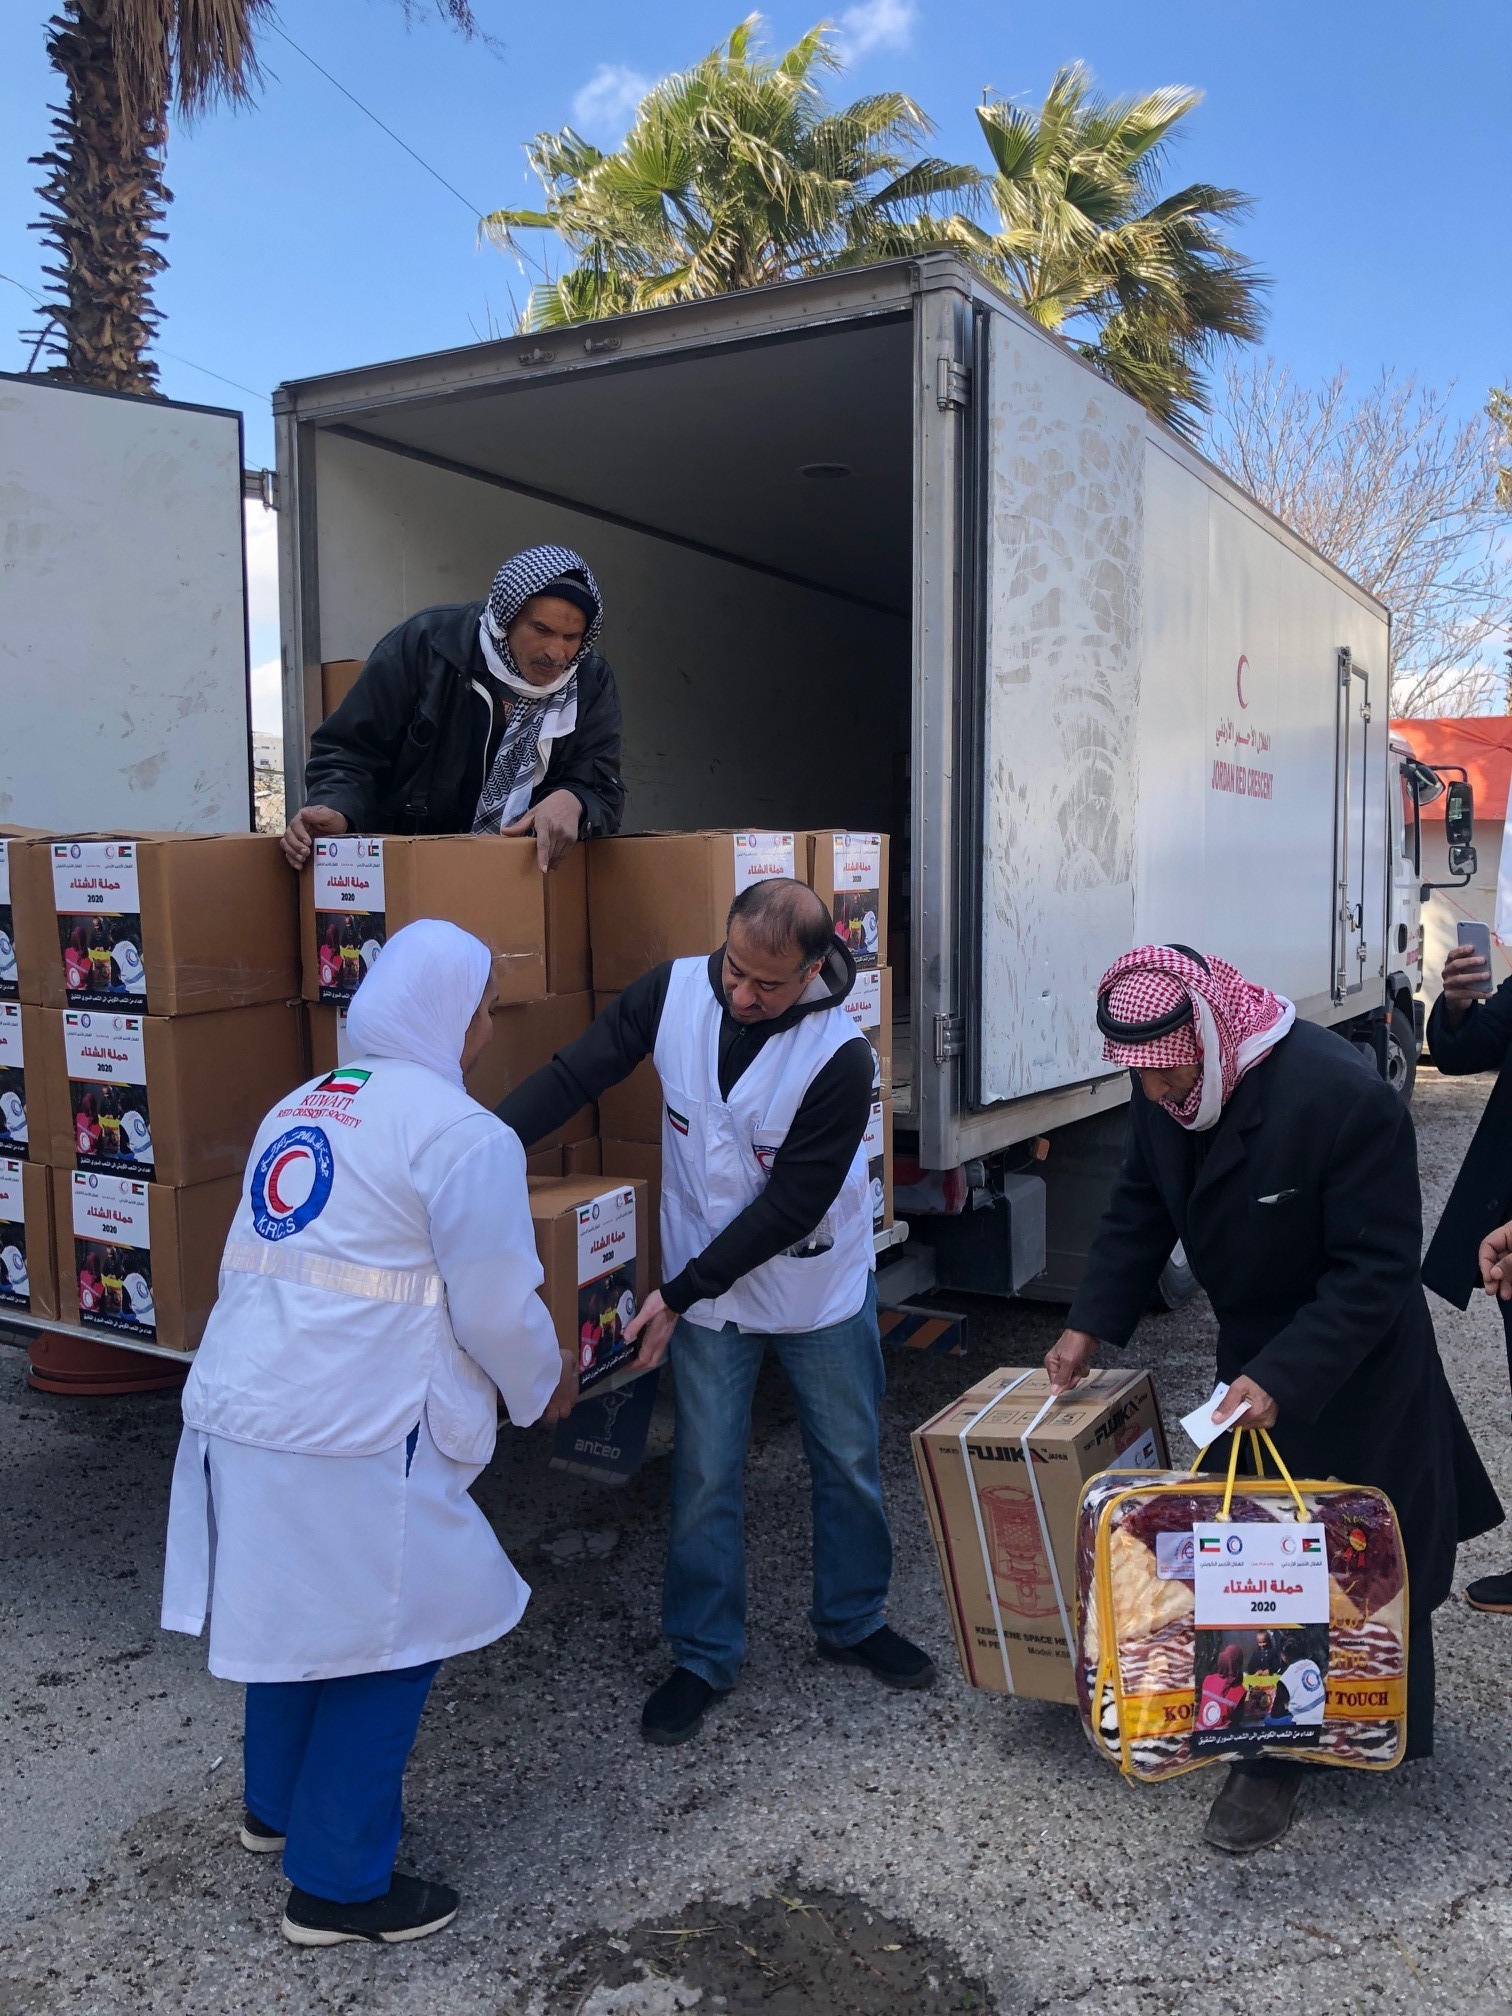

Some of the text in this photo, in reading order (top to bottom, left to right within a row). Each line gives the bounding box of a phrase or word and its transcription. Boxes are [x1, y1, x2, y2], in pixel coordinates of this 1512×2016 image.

[1212, 759, 1274, 800] JORDAN RED CRESCENT
[747, 863, 784, 875] حملة الشتاء
[69, 876, 121, 891] حملة الشتاء
[326, 875, 370, 889] حملة الشتاء
[87, 894, 104, 904] 2020
[341, 892, 356, 902] 2020
[80, 1045, 128, 1061] حملة الشتاء
[97, 1063, 113, 1073] 2020
[300, 1094, 355, 1111] KUWAIT
[277, 1108, 293, 1118] RED
[326, 1109, 362, 1129] SOCIETY
[86, 1206, 133, 1224] حملة الشتاء
[102, 1223, 118, 1234] 2020
[590, 1230, 626, 1254] حملة الشتاء
[574, 1438, 621, 1459] anteo
[967, 1444, 1050, 1464] FUJIKA
[1223, 1578, 1303, 1594] حملة الشتاء
[1250, 1601, 1277, 1612] 2020
[975, 1625, 1022, 1641] KEROENE
[1022, 1633, 1053, 1645] SPACE
[1335, 1690, 1389, 1707] TOUCH
